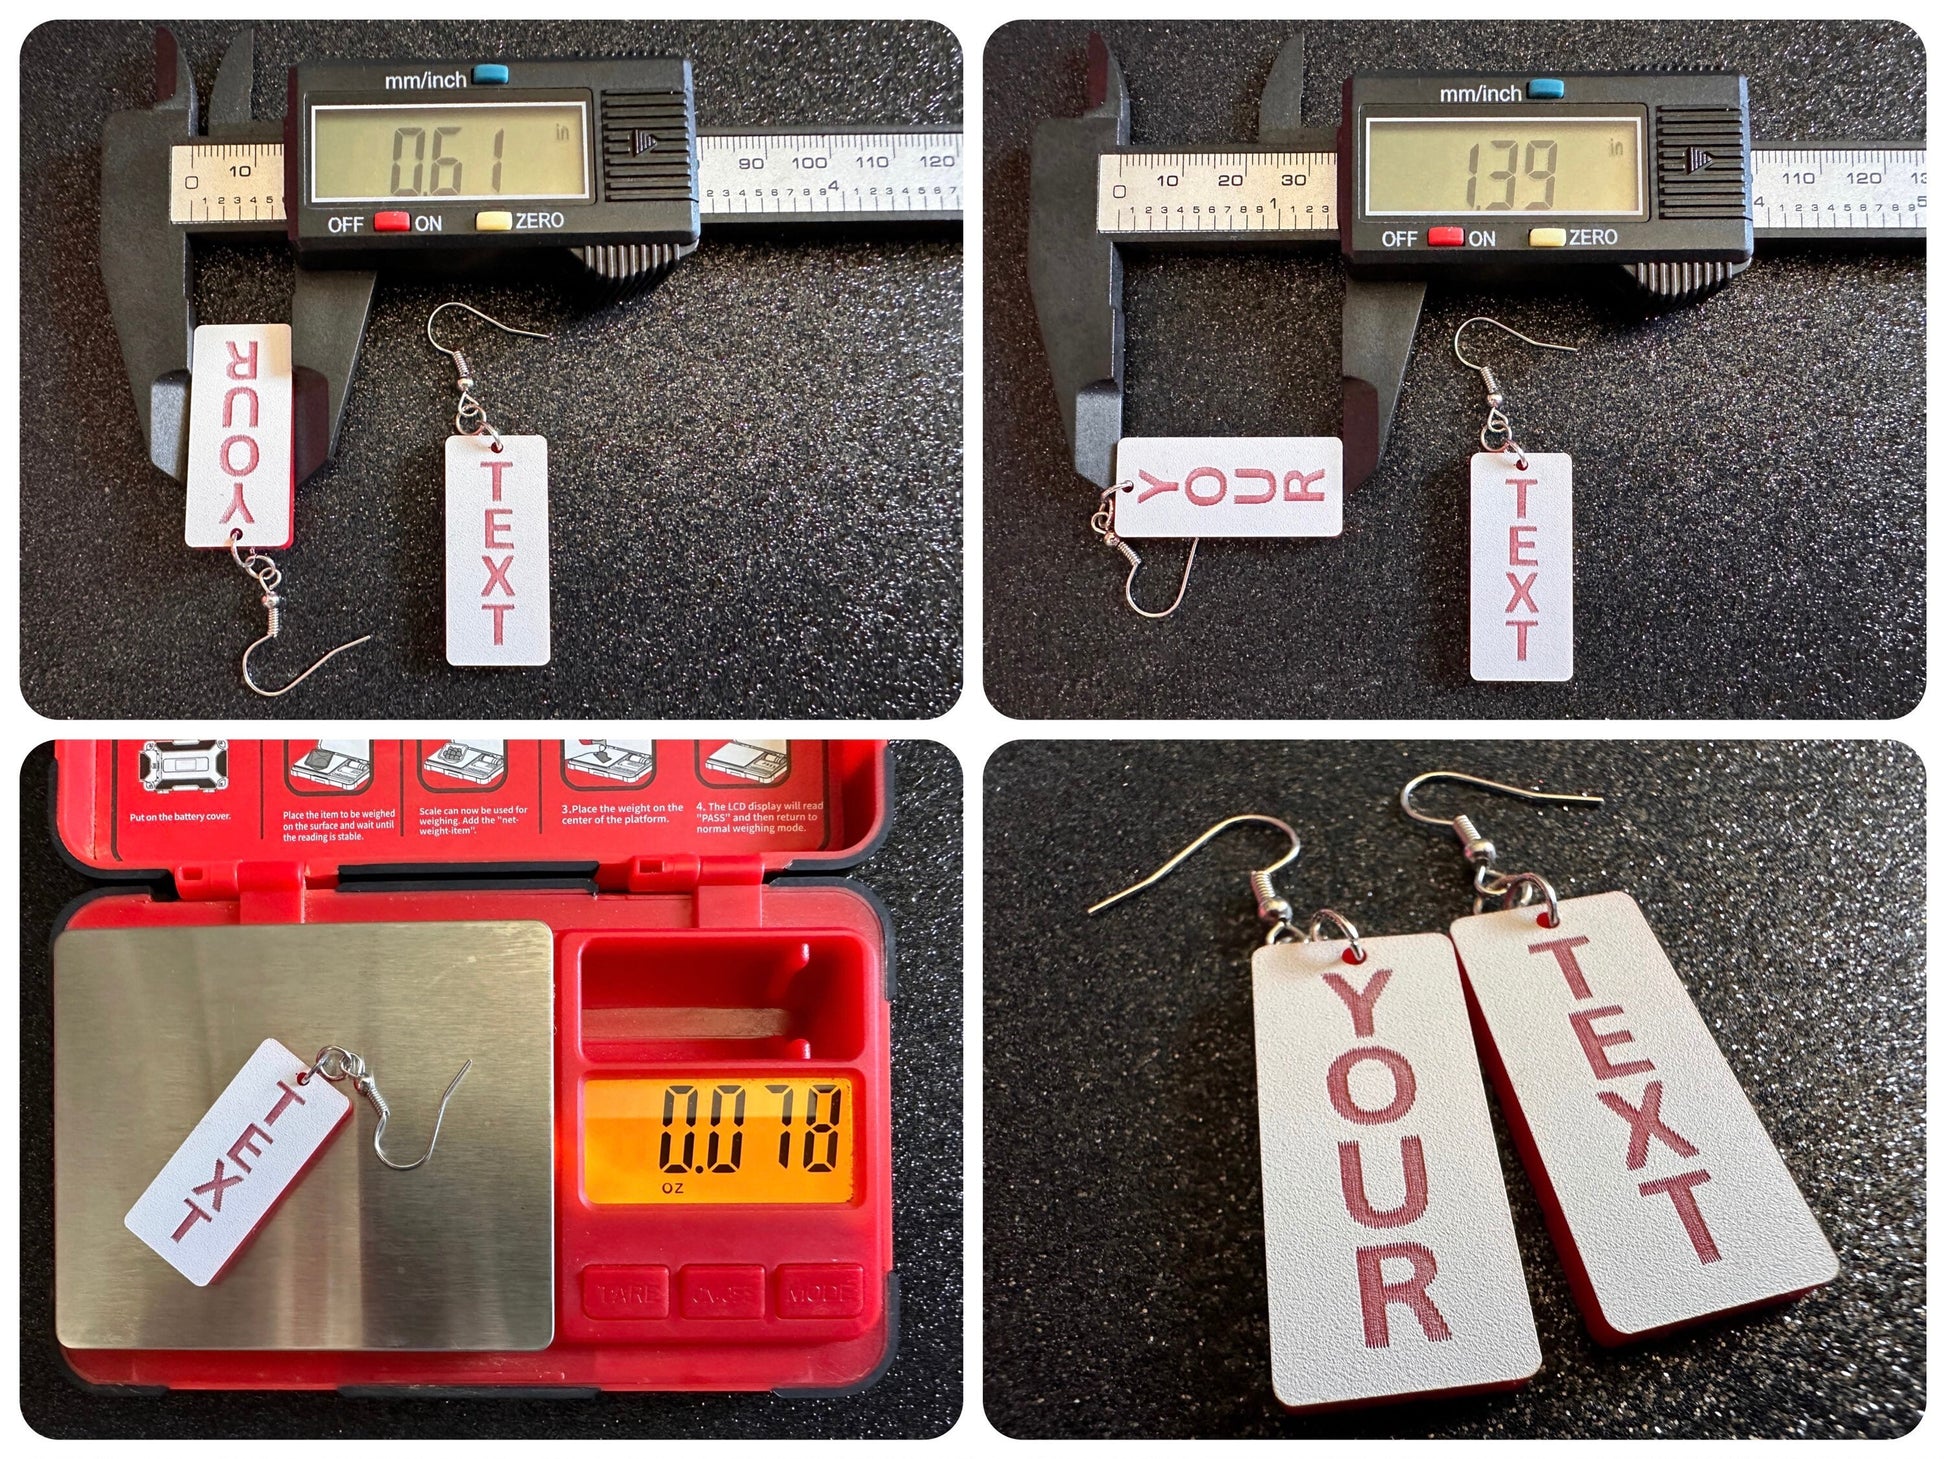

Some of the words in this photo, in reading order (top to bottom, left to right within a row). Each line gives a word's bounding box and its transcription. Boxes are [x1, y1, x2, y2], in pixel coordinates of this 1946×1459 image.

[385, 71, 467, 90] mm/inch
[1440, 84, 1522, 102] mm/inch
[390, 127, 504, 196] 0.61
[556, 123, 569, 141] in
[739, 158, 764, 169] 90
[792, 157, 827, 169] 100
[856, 156, 889, 168] 110
[920, 156, 955, 167] 120
[229, 166, 251, 177] 10
[1157, 175, 1178, 186] 10
[1218, 175, 1243, 186] 20
[1281, 174, 1306, 186] 30
[1466, 140, 1557, 210] 1.39
[1609, 138, 1623, 157] in
[1783, 172, 1815, 184] 110
[1847, 172, 1882, 184] 120
[828, 180, 839, 191] 4
[1270, 198, 1276, 209] 1
[1754, 196, 1765, 207] 4
[1876, 204, 1883, 212] 7
[1917, 195, 1927, 207] 5
[328, 216, 364, 233] OFF
[415, 215, 442, 232] ON
[515, 212, 565, 229] ZERO
[1382, 230, 1418, 247] OFF
[1468, 230, 1496, 247] ON
[1569, 228, 1618, 245] ZERO
[219, 340, 260, 526] YOUR
[1137, 466, 1326, 507] YOUR
[480, 461, 516, 646] TEXT
[1505, 479, 1539, 661] TEXT
[283, 811, 304, 819] Place
[306, 810, 319, 819] the
[320, 810, 339, 819] item
[340, 810, 349, 819] to
[350, 810, 360, 818] be
[362, 809, 396, 819] weighed
[419, 807, 442, 815] Scale
[461, 807, 479, 815] now
[481, 806, 492, 814] be
[493, 806, 514, 814] used
[515, 805, 528, 814] for
[599, 804, 616, 813] the
[618, 803, 651, 814] weight
[653, 804, 665, 812] on
[667, 803, 684, 812] the
[696, 802, 706, 811] 4.
[708, 802, 726, 811] The
[728, 802, 746, 811] LCD
[748, 801, 782, 812] display
[783, 801, 801, 810] will
[802, 801, 824, 810] read
[130, 813, 145, 822] Put
[159, 813, 173, 821] the
[174, 812, 205, 822] battery
[283, 823, 293, 831] on
[295, 822, 308, 830] the
[310, 821, 338, 830] surface
[340, 821, 355, 829] and
[357, 821, 374, 829] wait
[376, 820, 394, 829] until
[420, 817, 460, 826] weighing.
[462, 816, 479, 824] Add
[481, 816, 495, 824] the
[562, 816, 592, 824] center
[594, 815, 604, 824] of
[606, 815, 622, 824] the
[624, 814, 670, 825] platform.
[733, 813, 751, 822] and
[753, 812, 774, 822] then
[776, 812, 806, 821] return
[808, 813, 818, 821] to
[283, 833, 296, 841] the
[298, 833, 328, 843] reading
[329, 833, 336, 841] is
[338, 832, 364, 841] stable.
[697, 824, 730, 833] normal
[732, 824, 775, 835] weighing
[777, 823, 807, 832] mode.
[1528, 935, 1722, 1266] TEXT
[659, 1085, 841, 1173] 0.078
[171, 1080, 305, 1243] TEXT
[1320, 967, 1452, 1349] YOUR
